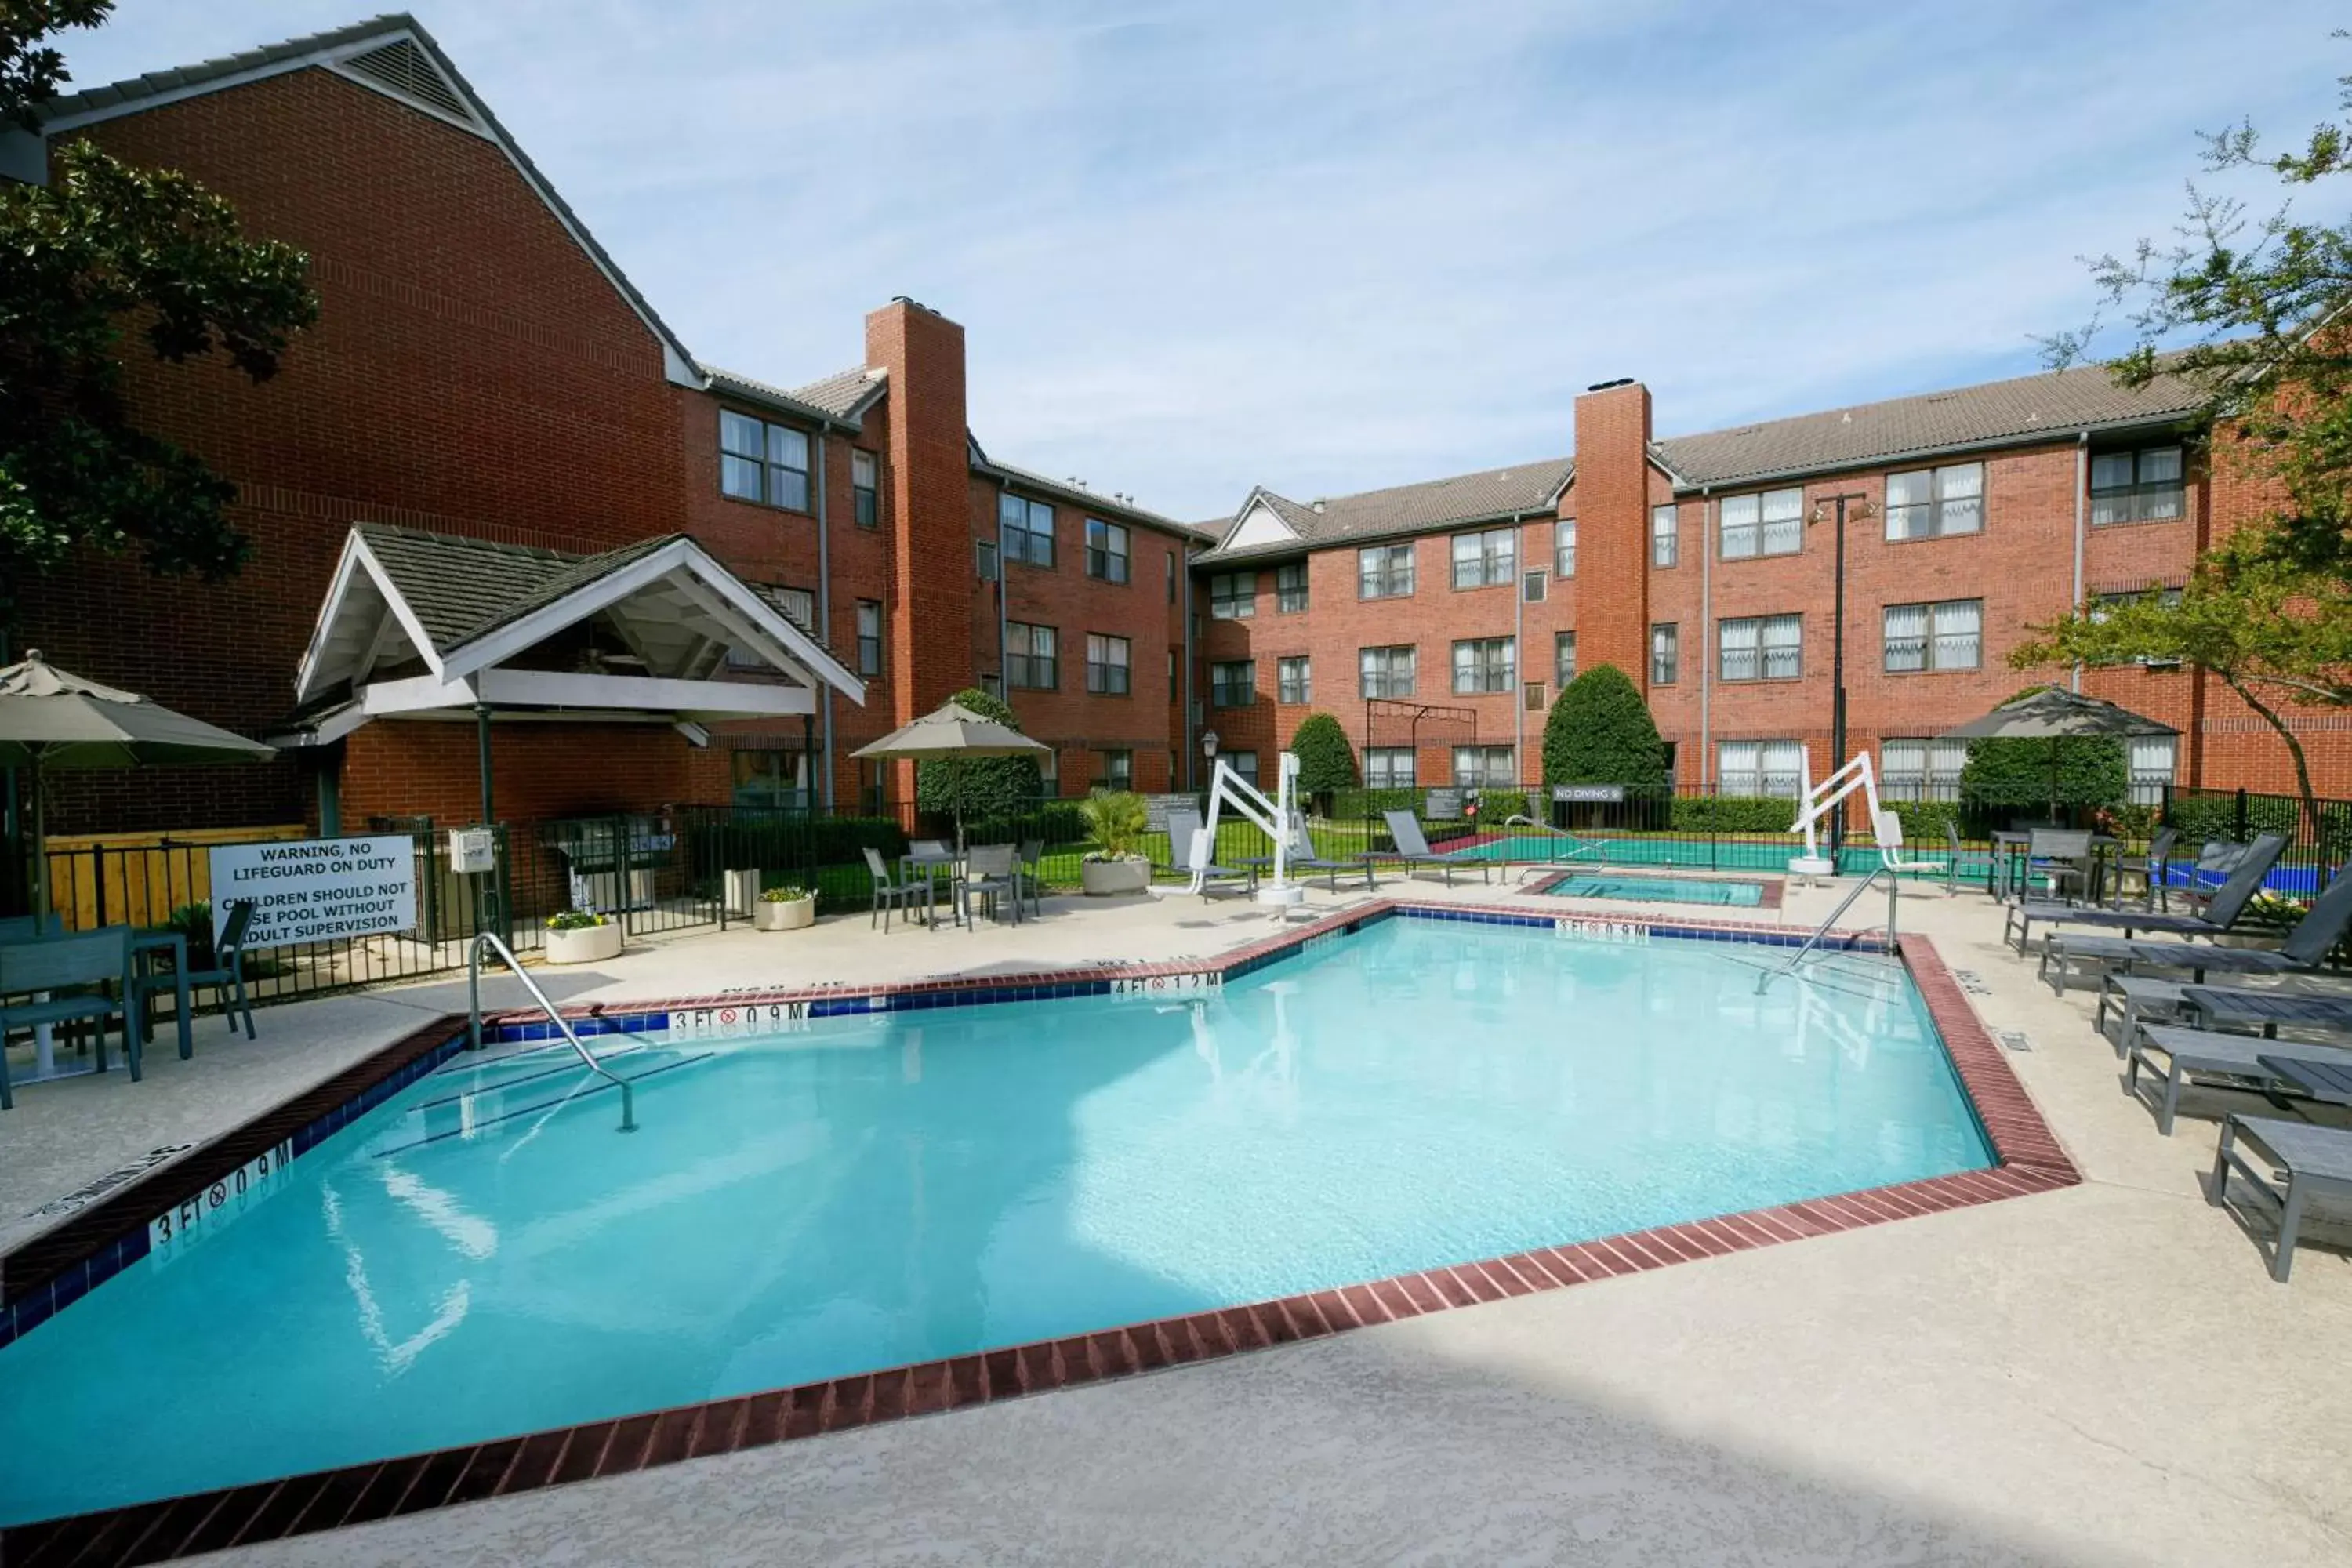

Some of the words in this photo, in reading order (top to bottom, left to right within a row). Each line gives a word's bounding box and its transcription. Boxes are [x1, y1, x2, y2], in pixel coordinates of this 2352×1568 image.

[1573, 789, 1608, 798] DIVING
[260, 844, 345, 862] WARNING,
[350, 843, 371, 855] NO
[234, 863, 325, 880] LIFEGUARD
[332, 860, 353, 873] ON
[357, 858, 396, 871] DUTY
[313, 886, 374, 902] SHOULD
[379, 883, 408, 895] NOT
[252, 912, 271, 926] SE
[277, 907, 319, 923] POOL
[323, 899, 394, 917] WITHOUT
[295, 915, 398, 937] SUPERVISION
[1132, 977, 1145, 992] FT
[676, 1012, 686, 1029] 3
[695, 1010, 713, 1028] FT
[788, 1003, 803, 1021] M
[158, 1215, 172, 1243] 3
[180, 1195, 203, 1229] FT
[276, 1141, 289, 1171] M
